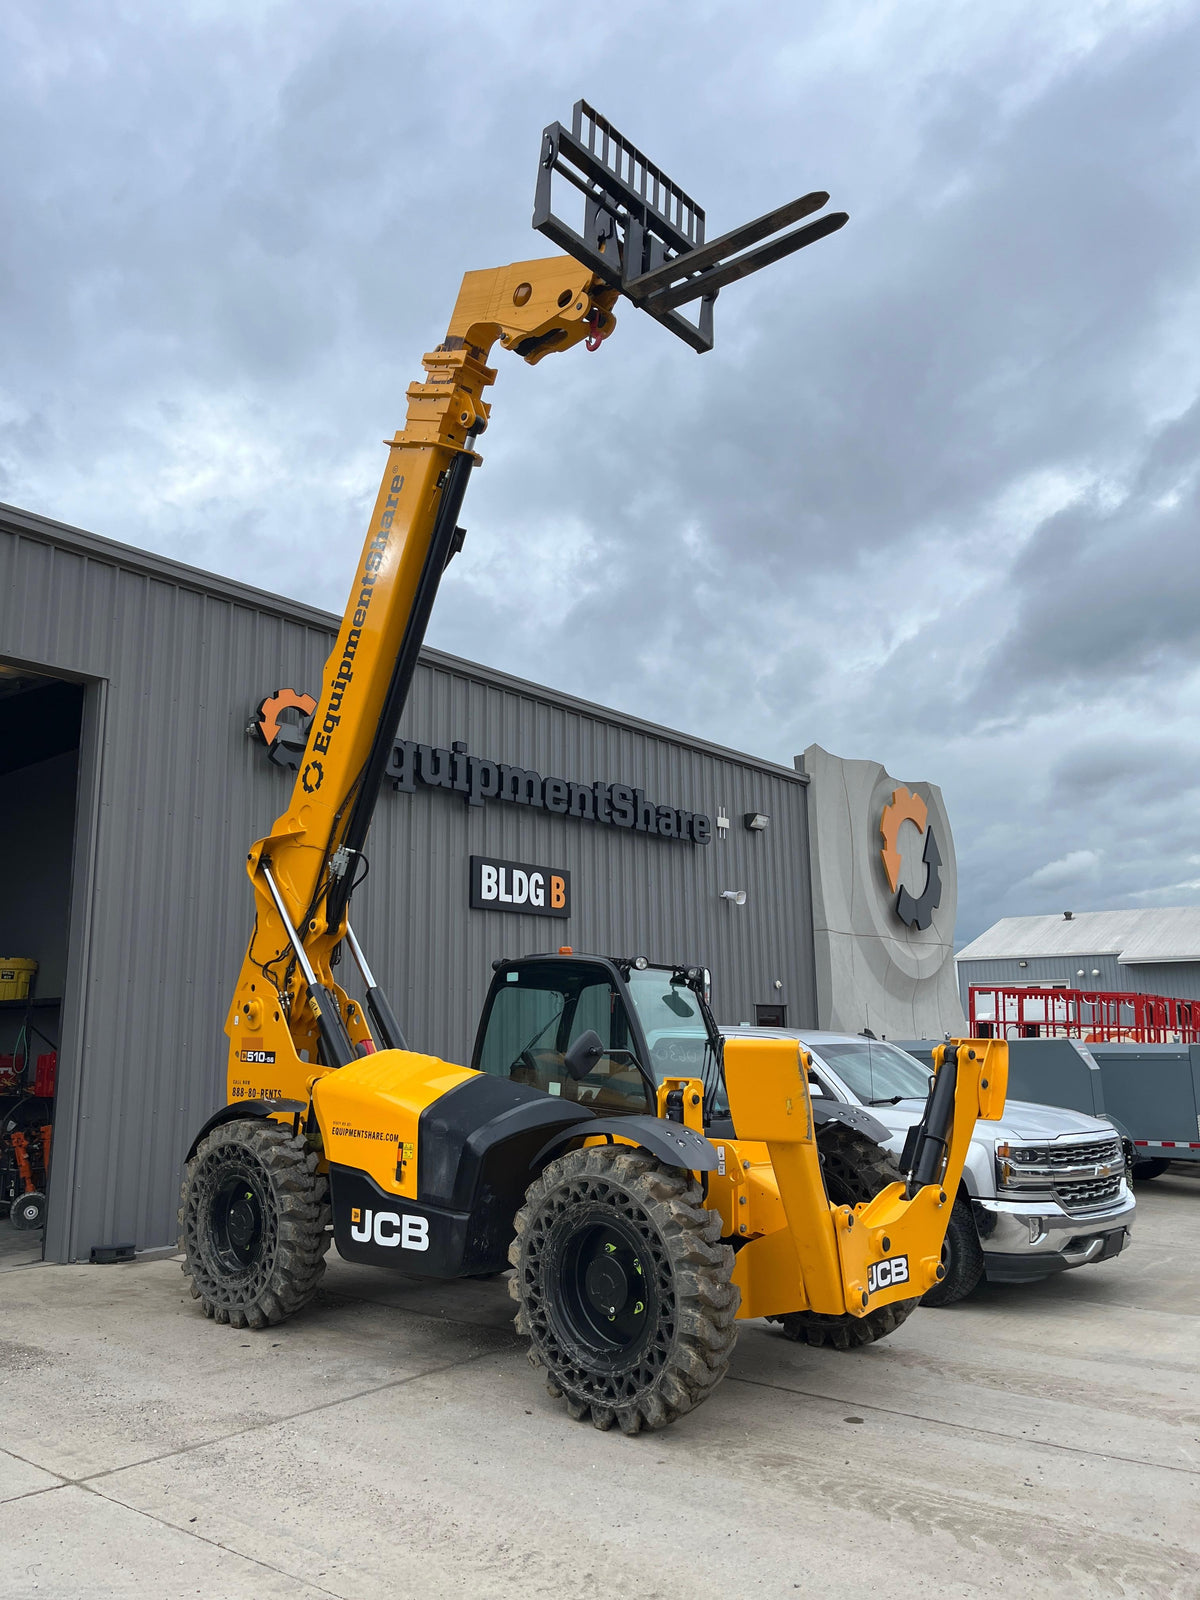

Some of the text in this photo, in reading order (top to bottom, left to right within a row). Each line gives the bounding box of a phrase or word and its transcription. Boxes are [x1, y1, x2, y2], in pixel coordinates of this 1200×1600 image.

[385, 738, 711, 845] quipmentShare
[481, 864, 566, 909] BLDG B
[232, 1087, 282, 1099] 888-80-RENTS
[332, 1126, 399, 1142] EQUIPMENTSHARE.COM
[351, 1209, 430, 1252] JCB
[869, 1257, 908, 1292] JCB
